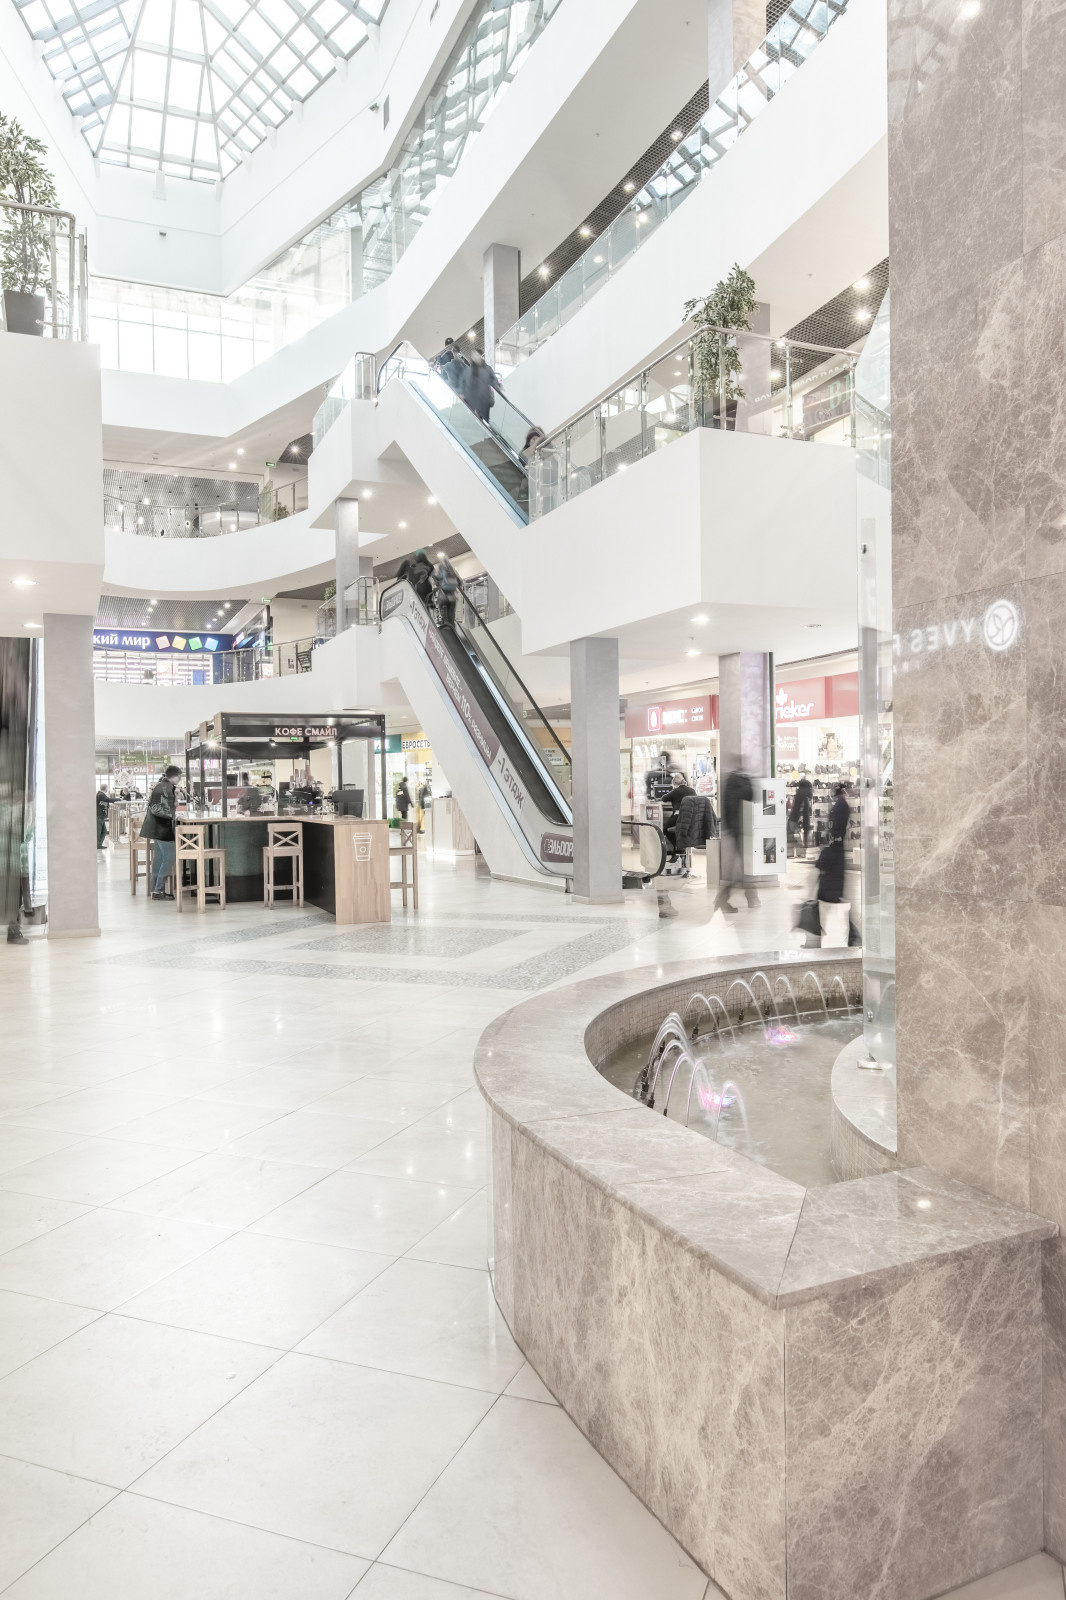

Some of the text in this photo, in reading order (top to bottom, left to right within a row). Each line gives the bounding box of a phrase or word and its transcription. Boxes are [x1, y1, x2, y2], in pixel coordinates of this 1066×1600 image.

[121, 635, 151, 649] мир
[275, 725, 338, 736] КОФЕ СМАЙЛ
[498, 757, 525, 810] -1 ЭТАЖ
